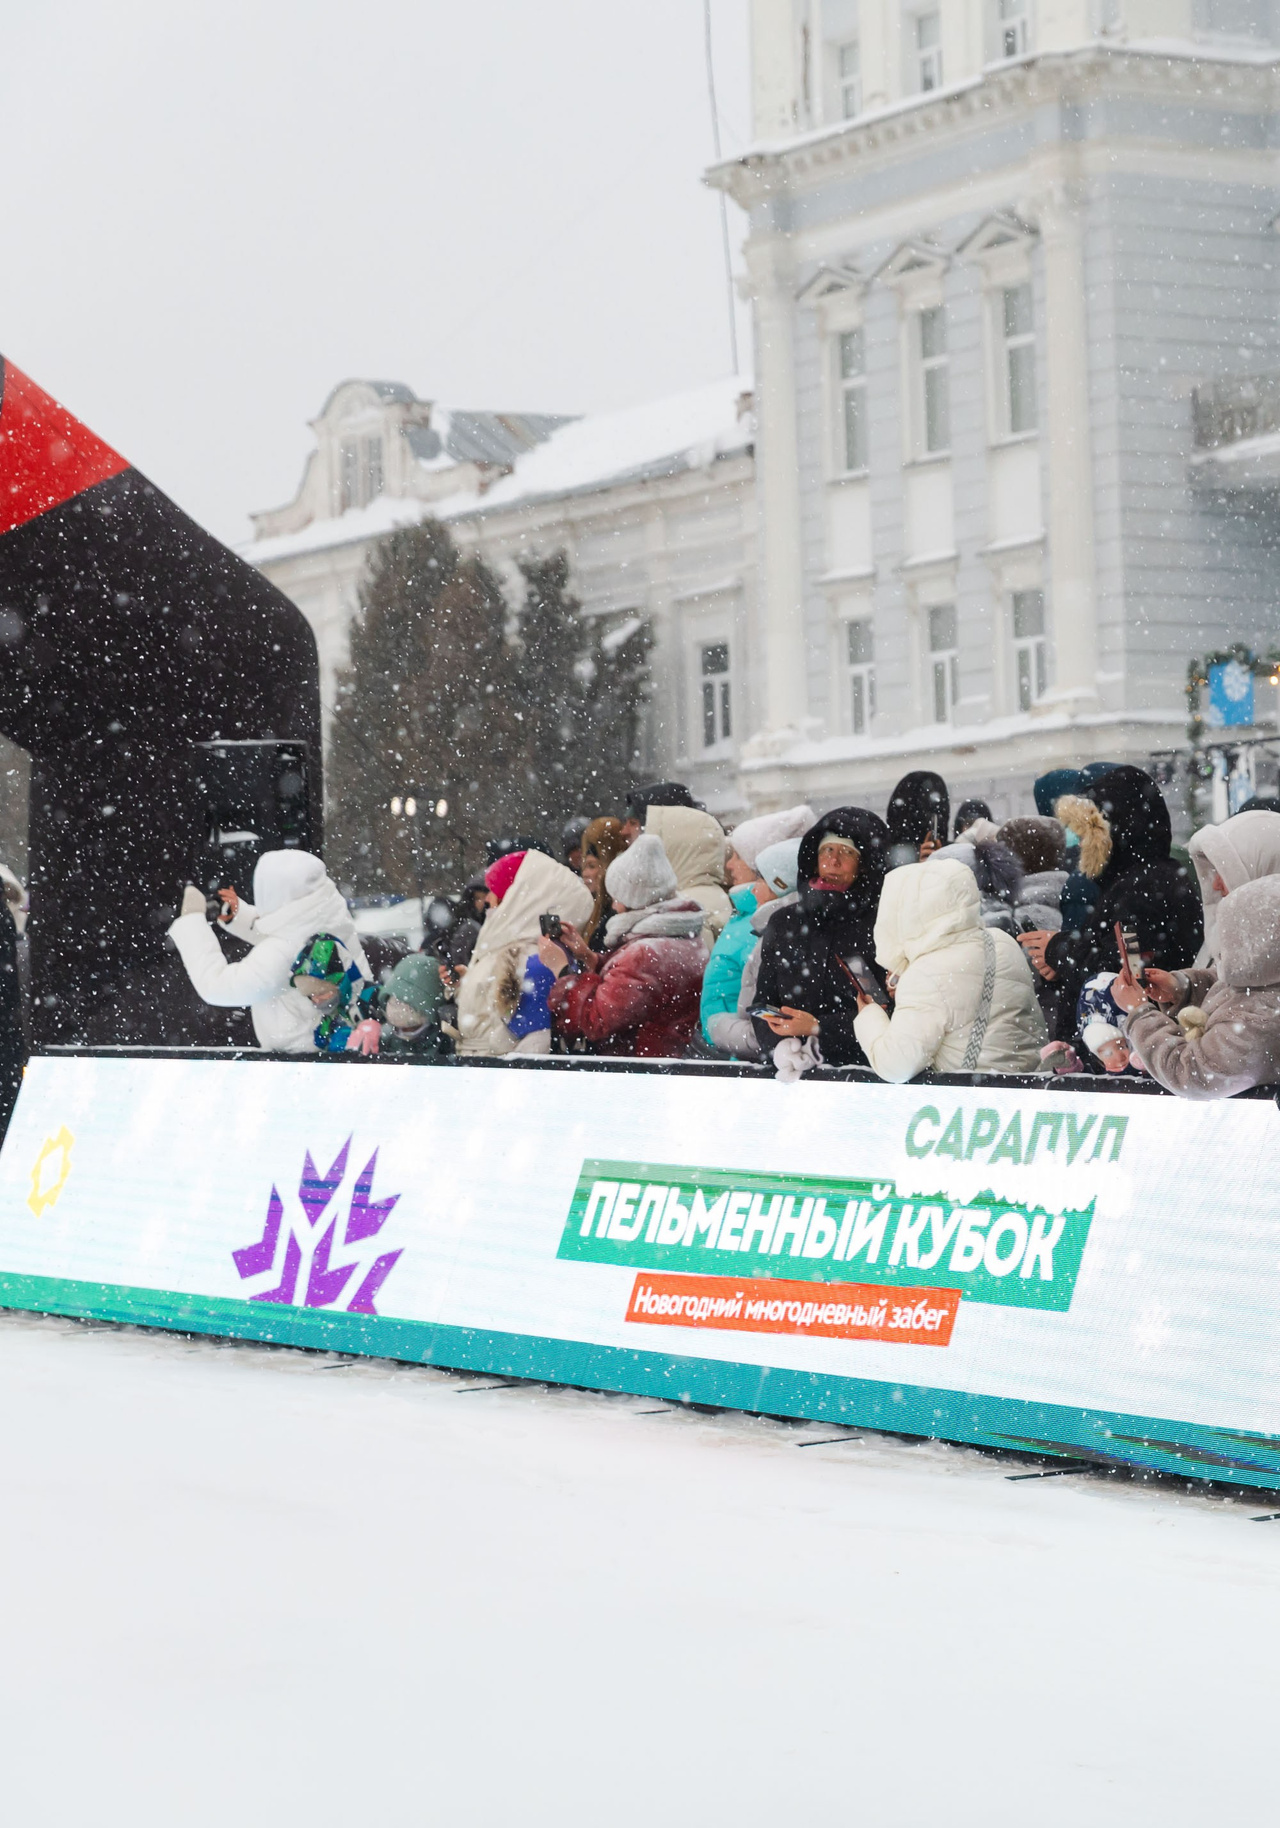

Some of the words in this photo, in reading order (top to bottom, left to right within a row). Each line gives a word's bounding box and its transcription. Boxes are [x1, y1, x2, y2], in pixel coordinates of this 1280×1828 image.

[905, 1104, 1129, 1167] САРАПУЛ
[579, 1180, 891, 1263] ПЕЛЬМЕННЫЙ
[888, 1204, 1067, 1281] КУБОК
[633, 1285, 743, 1319] Новогодний
[744, 1298, 887, 1328] многодневный
[888, 1299, 949, 1330] забег
